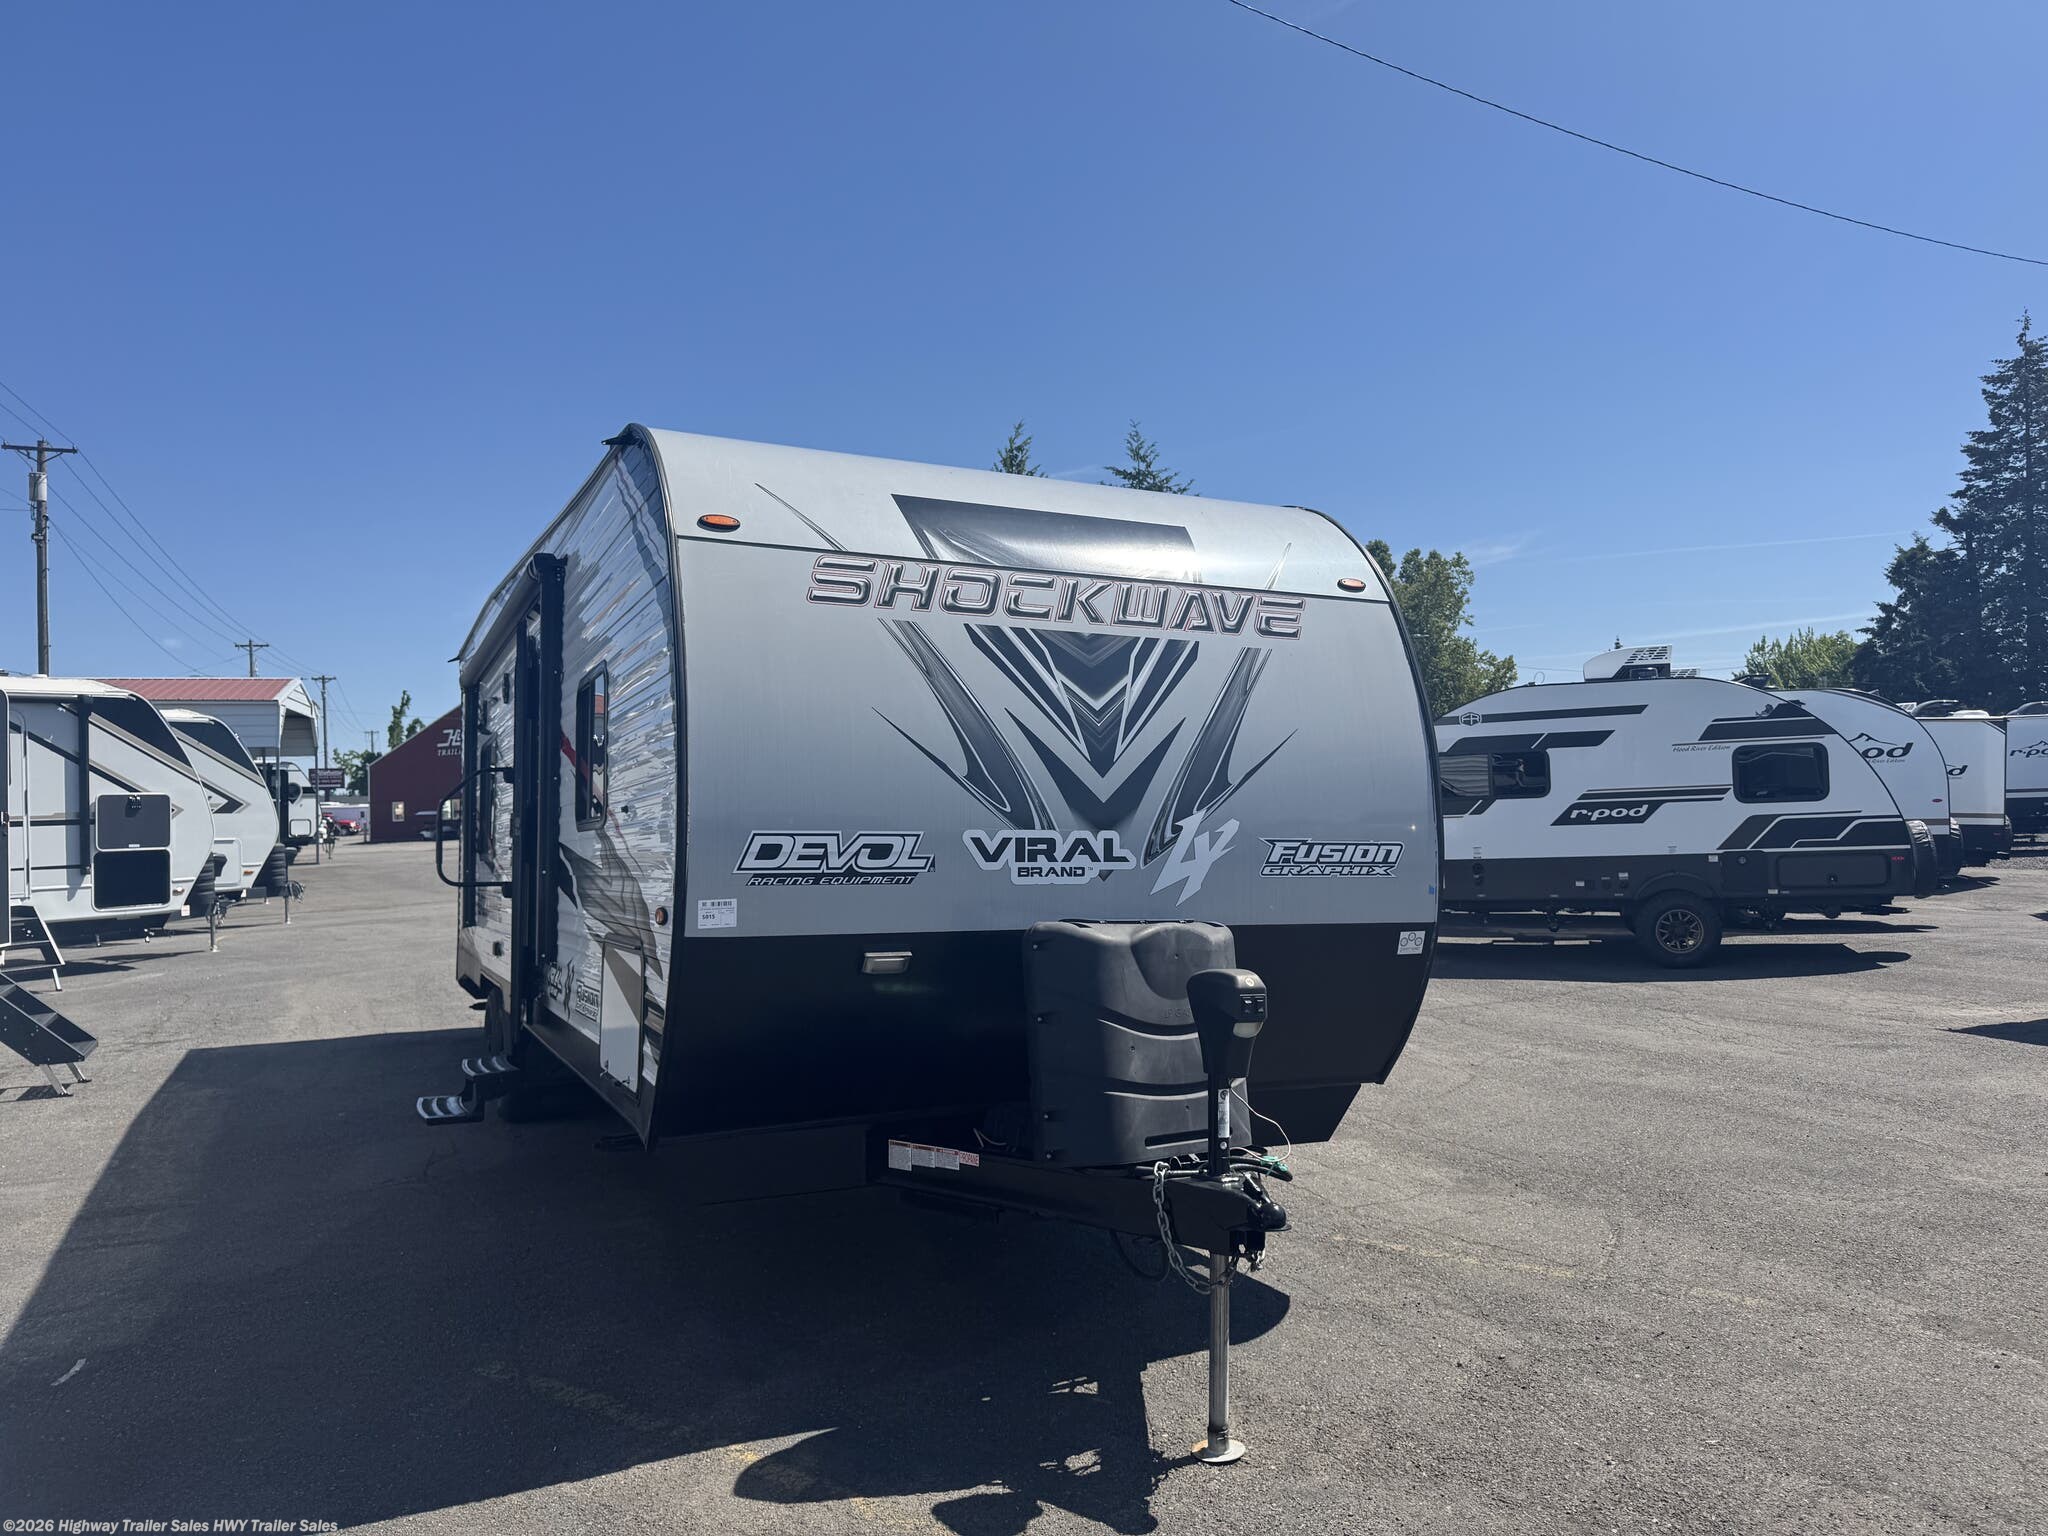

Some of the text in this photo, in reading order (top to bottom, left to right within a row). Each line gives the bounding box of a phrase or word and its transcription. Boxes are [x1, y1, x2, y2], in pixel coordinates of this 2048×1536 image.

[807, 554, 1305, 640] SHOCKWAVE
[736, 832, 934, 873] DEVOL
[970, 837, 1130, 863] VIRAL
[1264, 840, 1403, 863] FUSION
[747, 876, 916, 886] RACING EQUIPMENT
[1017, 866, 1086, 878] BRAND
[1261, 865, 1396, 876] GRAPHIX
